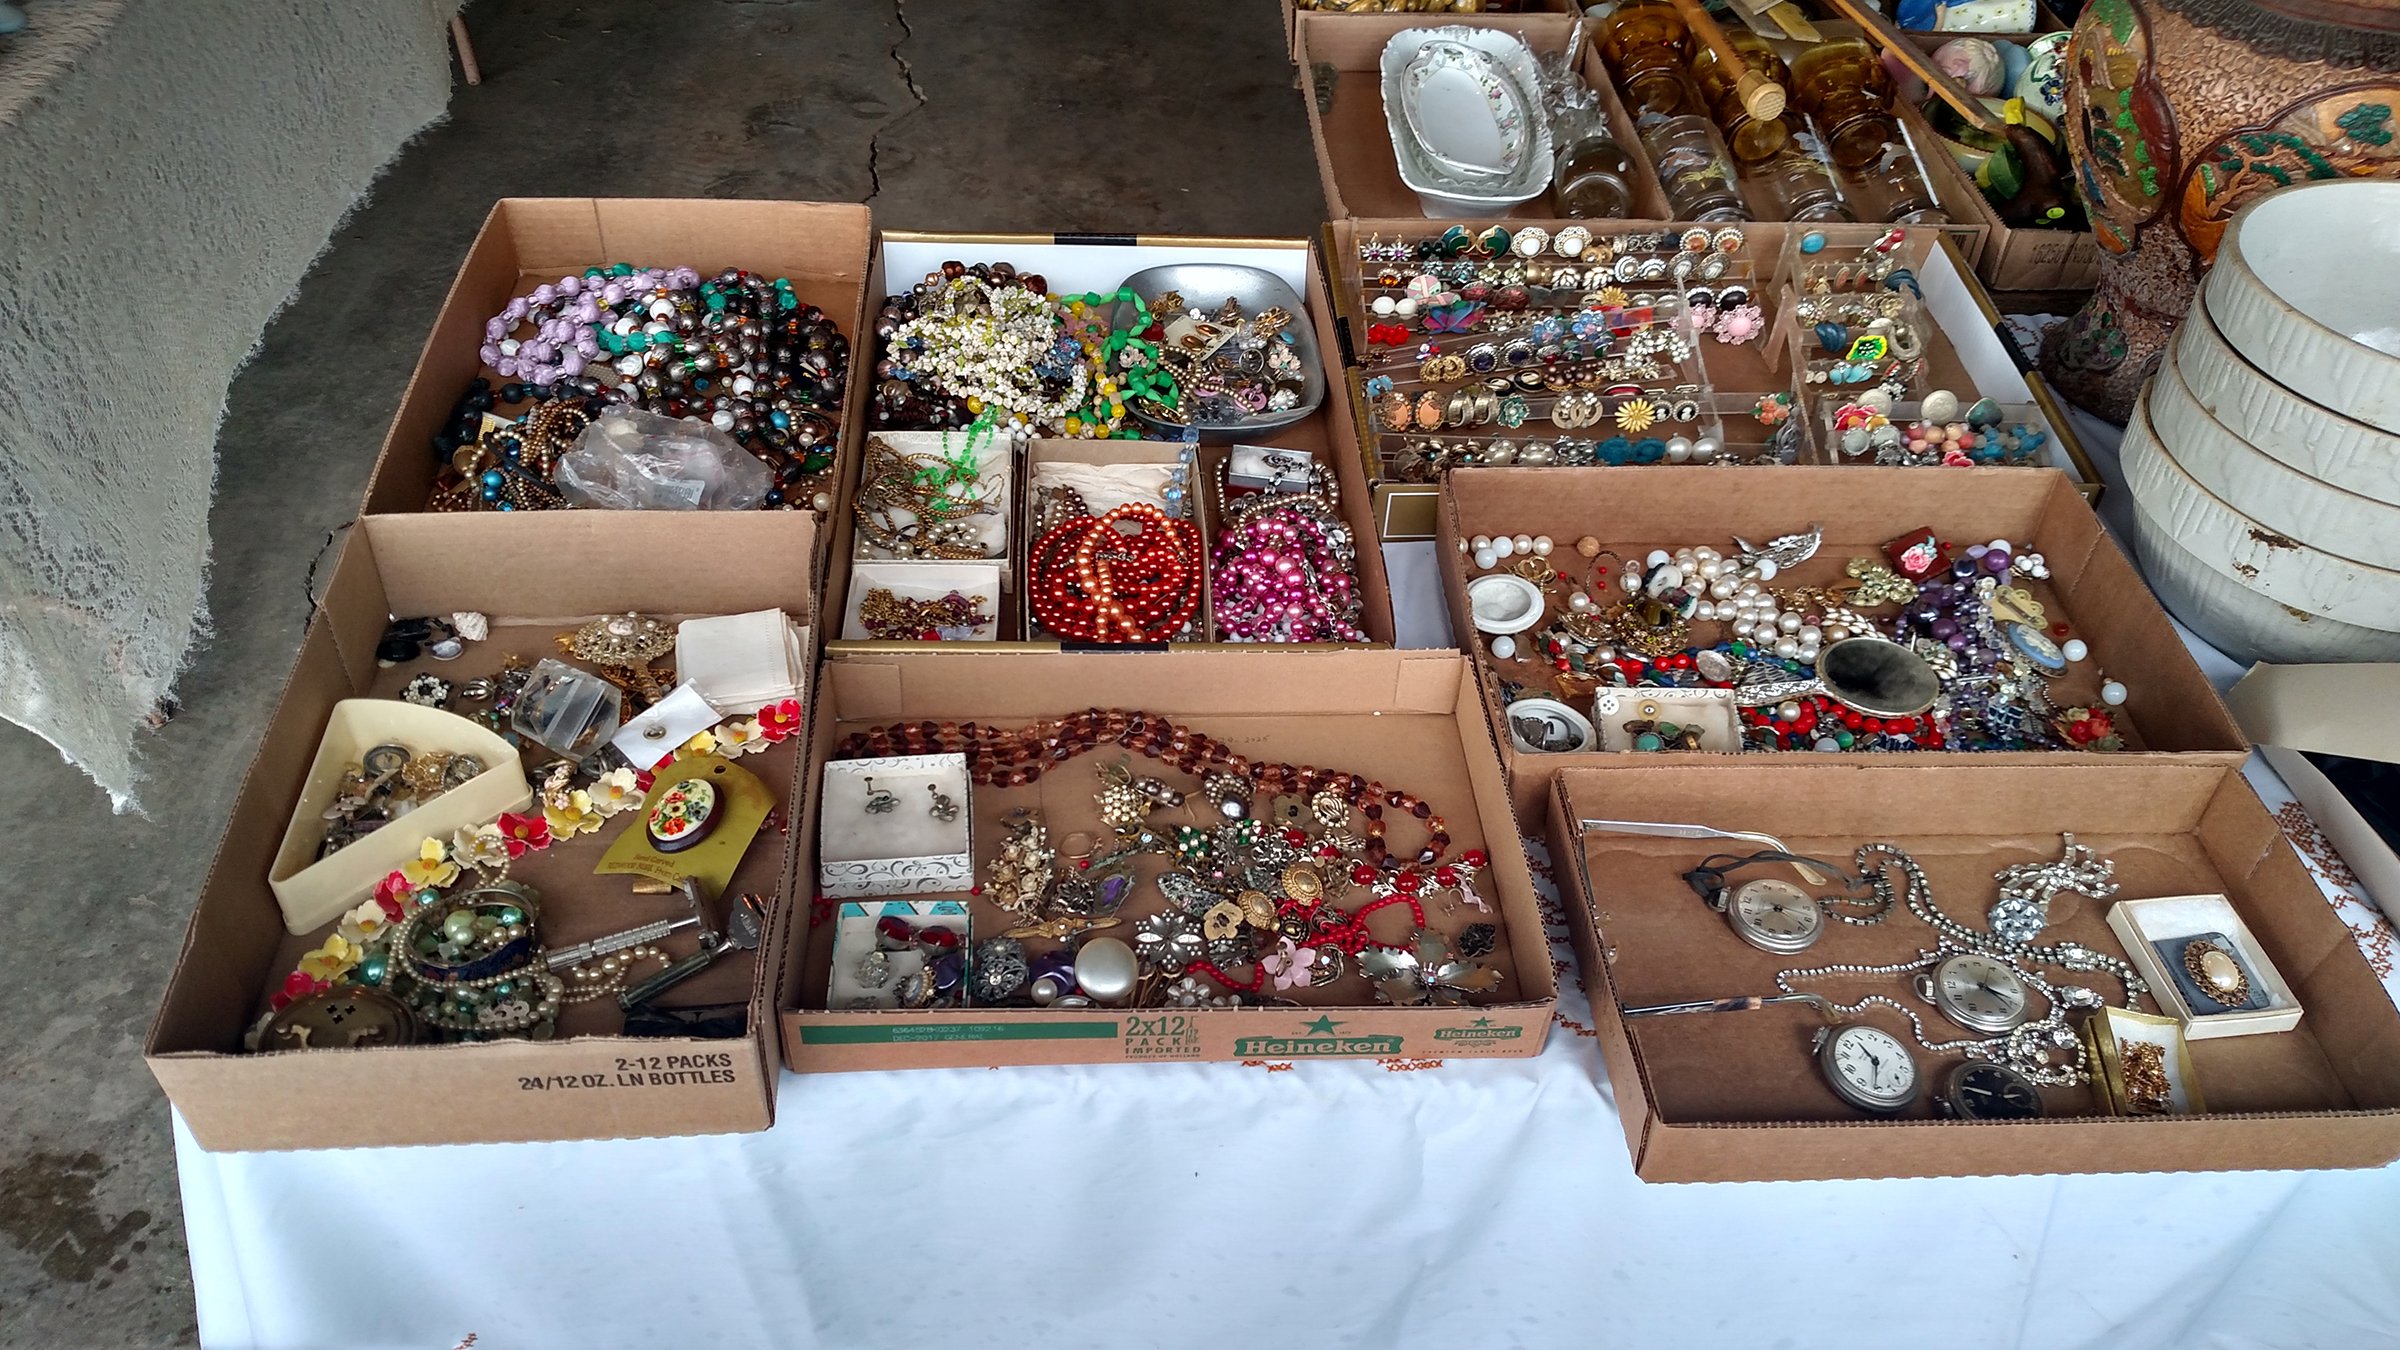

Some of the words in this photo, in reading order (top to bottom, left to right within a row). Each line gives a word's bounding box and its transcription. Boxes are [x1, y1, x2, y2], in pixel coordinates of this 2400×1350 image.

[1125, 1015, 1185, 1036] 2x12
[1440, 1029, 1516, 1038] Heineken
[1867, 1033, 1877, 1042] 2
[1125, 1037, 1181, 1046] PACK
[1842, 1039, 1854, 1050] 12
[1882, 1040, 1894, 1049] 3
[1125, 1046, 1201, 1054] IMPORTED
[1244, 1040, 1391, 1055] Heineken
[1840, 1051, 1851, 1060] 11
[1895, 1052, 1905, 1061] 4
[615, 1057, 663, 1071] 2-12
[667, 1053, 732, 1070] PACKS
[1844, 1063, 1857, 1075] 10
[518, 1075, 579, 1090] 24/12
[582, 1072, 615, 1088] OZ.
[618, 1073, 645, 1087] LN
[650, 1069, 736, 1086] BOTTLES
[1856, 1077, 1867, 1087] 9
[1873, 1084, 1884, 1093] 8
[1886, 1084, 1897, 1092] 7
